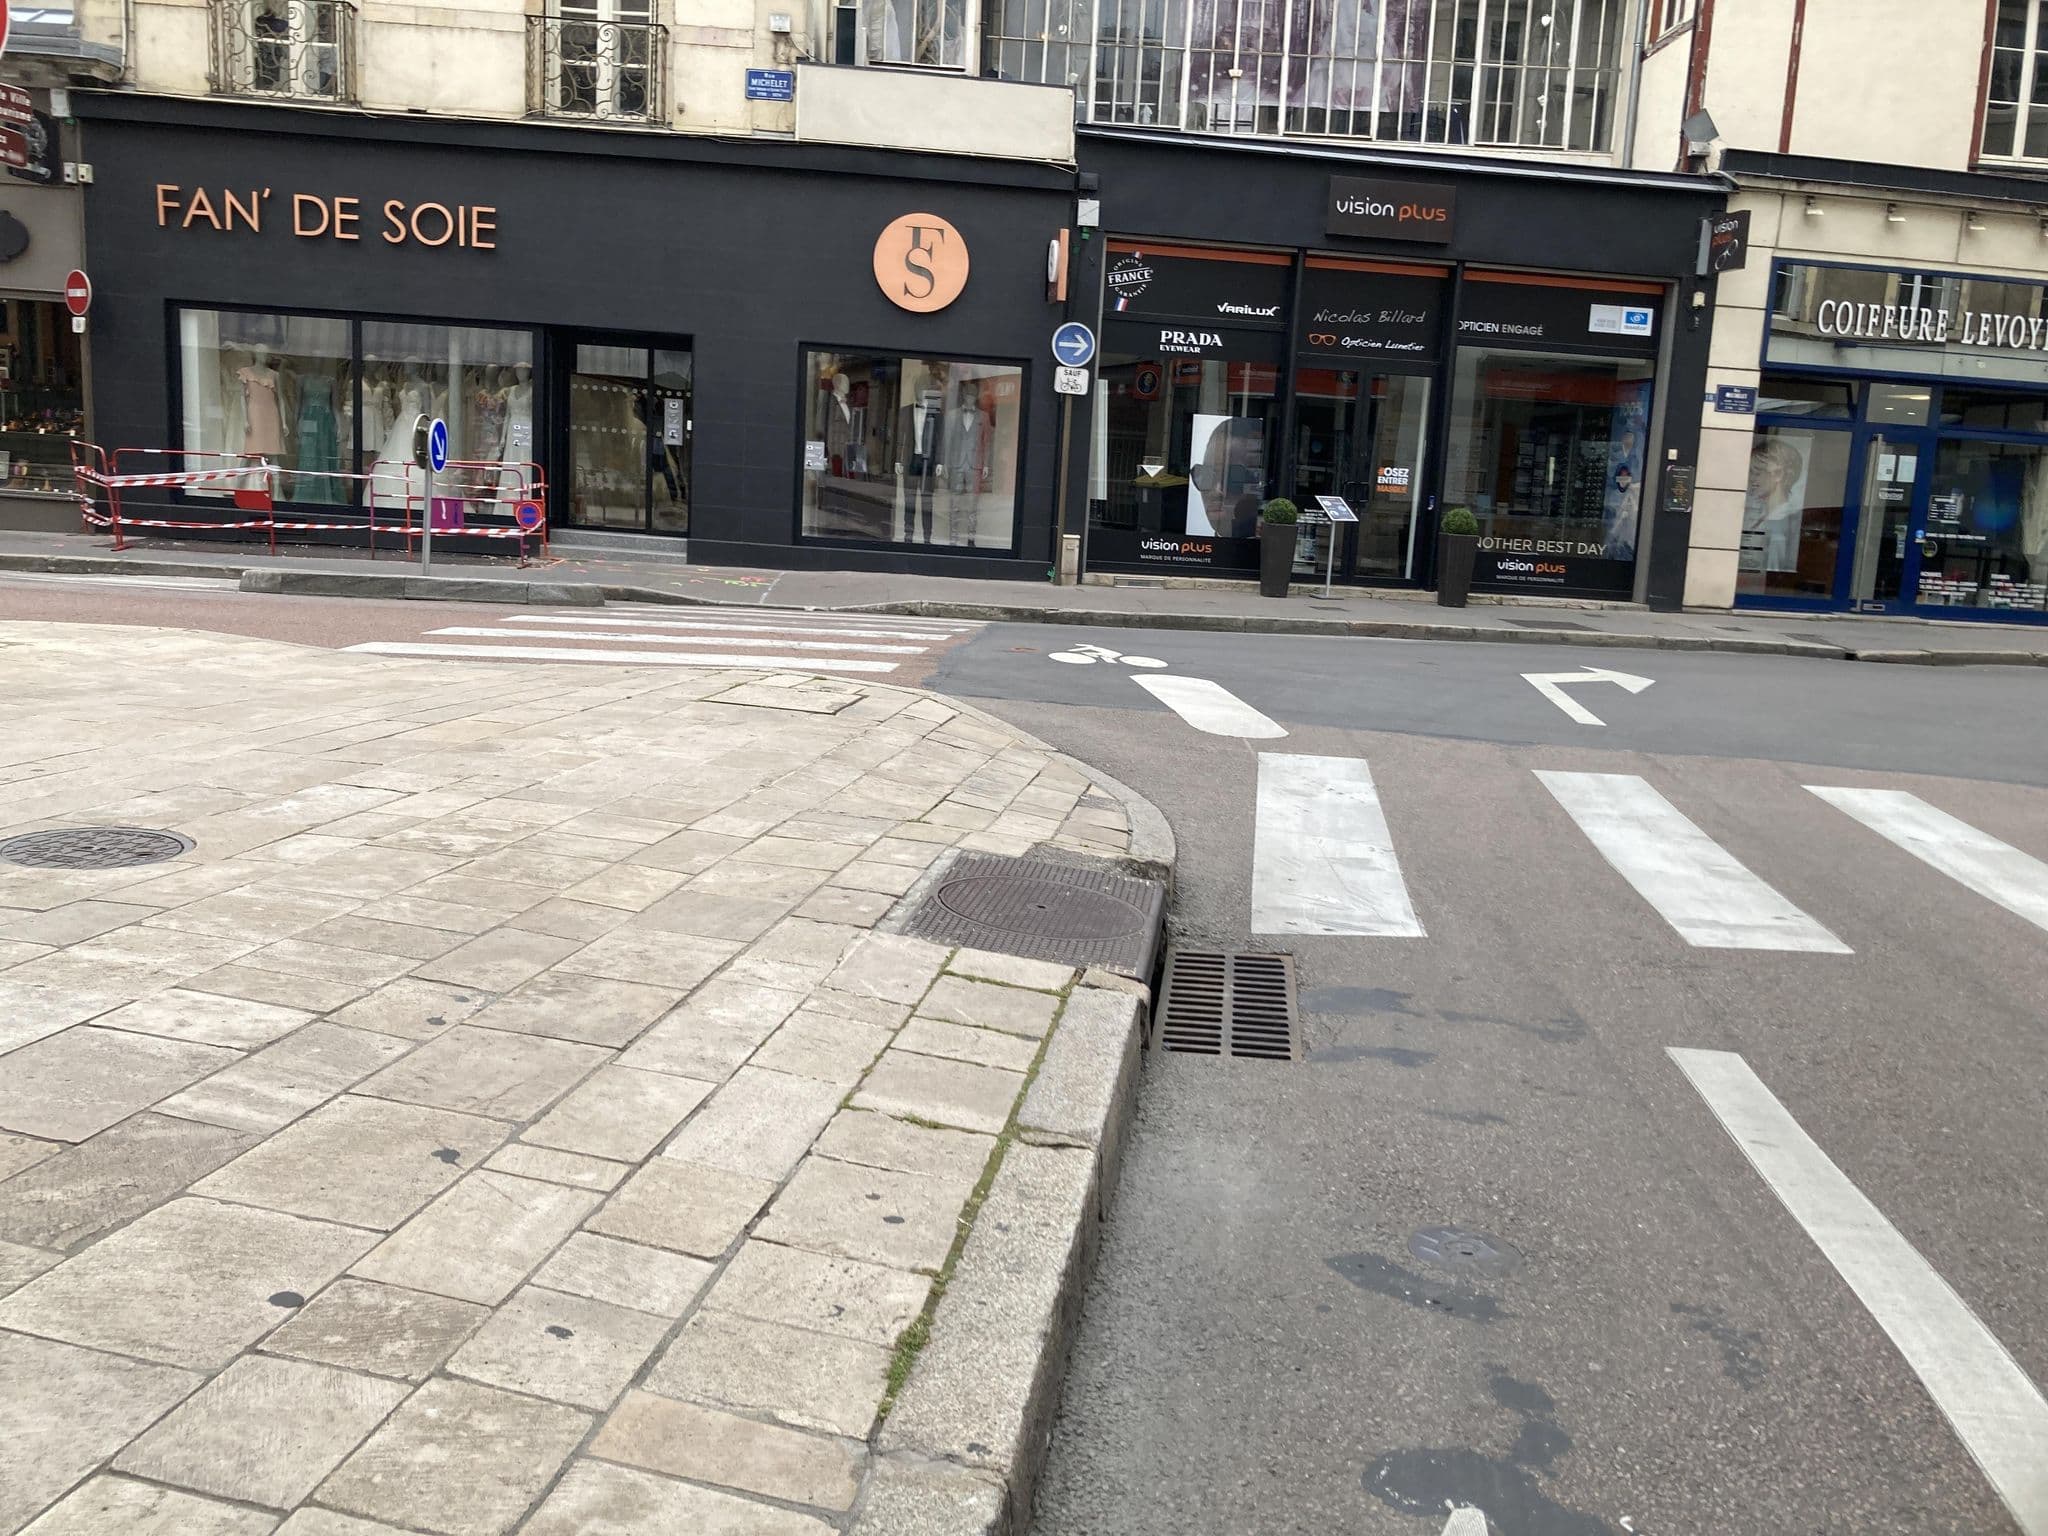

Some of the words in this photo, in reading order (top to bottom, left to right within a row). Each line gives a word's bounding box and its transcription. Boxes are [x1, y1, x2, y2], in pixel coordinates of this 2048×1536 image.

[751, 79, 788, 88] MICHELET
[1336, 195, 1394, 217] vision
[1399, 204, 1447, 222] plus
[156, 184, 271, 233] FAN'
[293, 194, 360, 240] DE
[382, 200, 496, 249] SOIE
[1714, 219, 1739, 233] vision
[1108, 269, 1151, 284] FRANCE
[1313, 309, 1372, 323] Nicolas
[1378, 310, 1426, 323] Billard
[1818, 299, 1949, 342] COIFFURE
[1160, 330, 1223, 347] PRADA
[1340, 337, 1382, 348] Opticien
[1385, 340, 1425, 351] Lunetier
[1159, 345, 1201, 353] EYEWEAR
[1377, 476, 1409, 485] ENTRER
[1141, 538, 1179, 551] vision
[1181, 542, 1212, 553] plus
[1536, 540, 1574, 553] BEST
[1577, 543, 1607, 556] DAY
[1497, 559, 1534, 572] vision
[1535, 562, 1566, 574] plus
